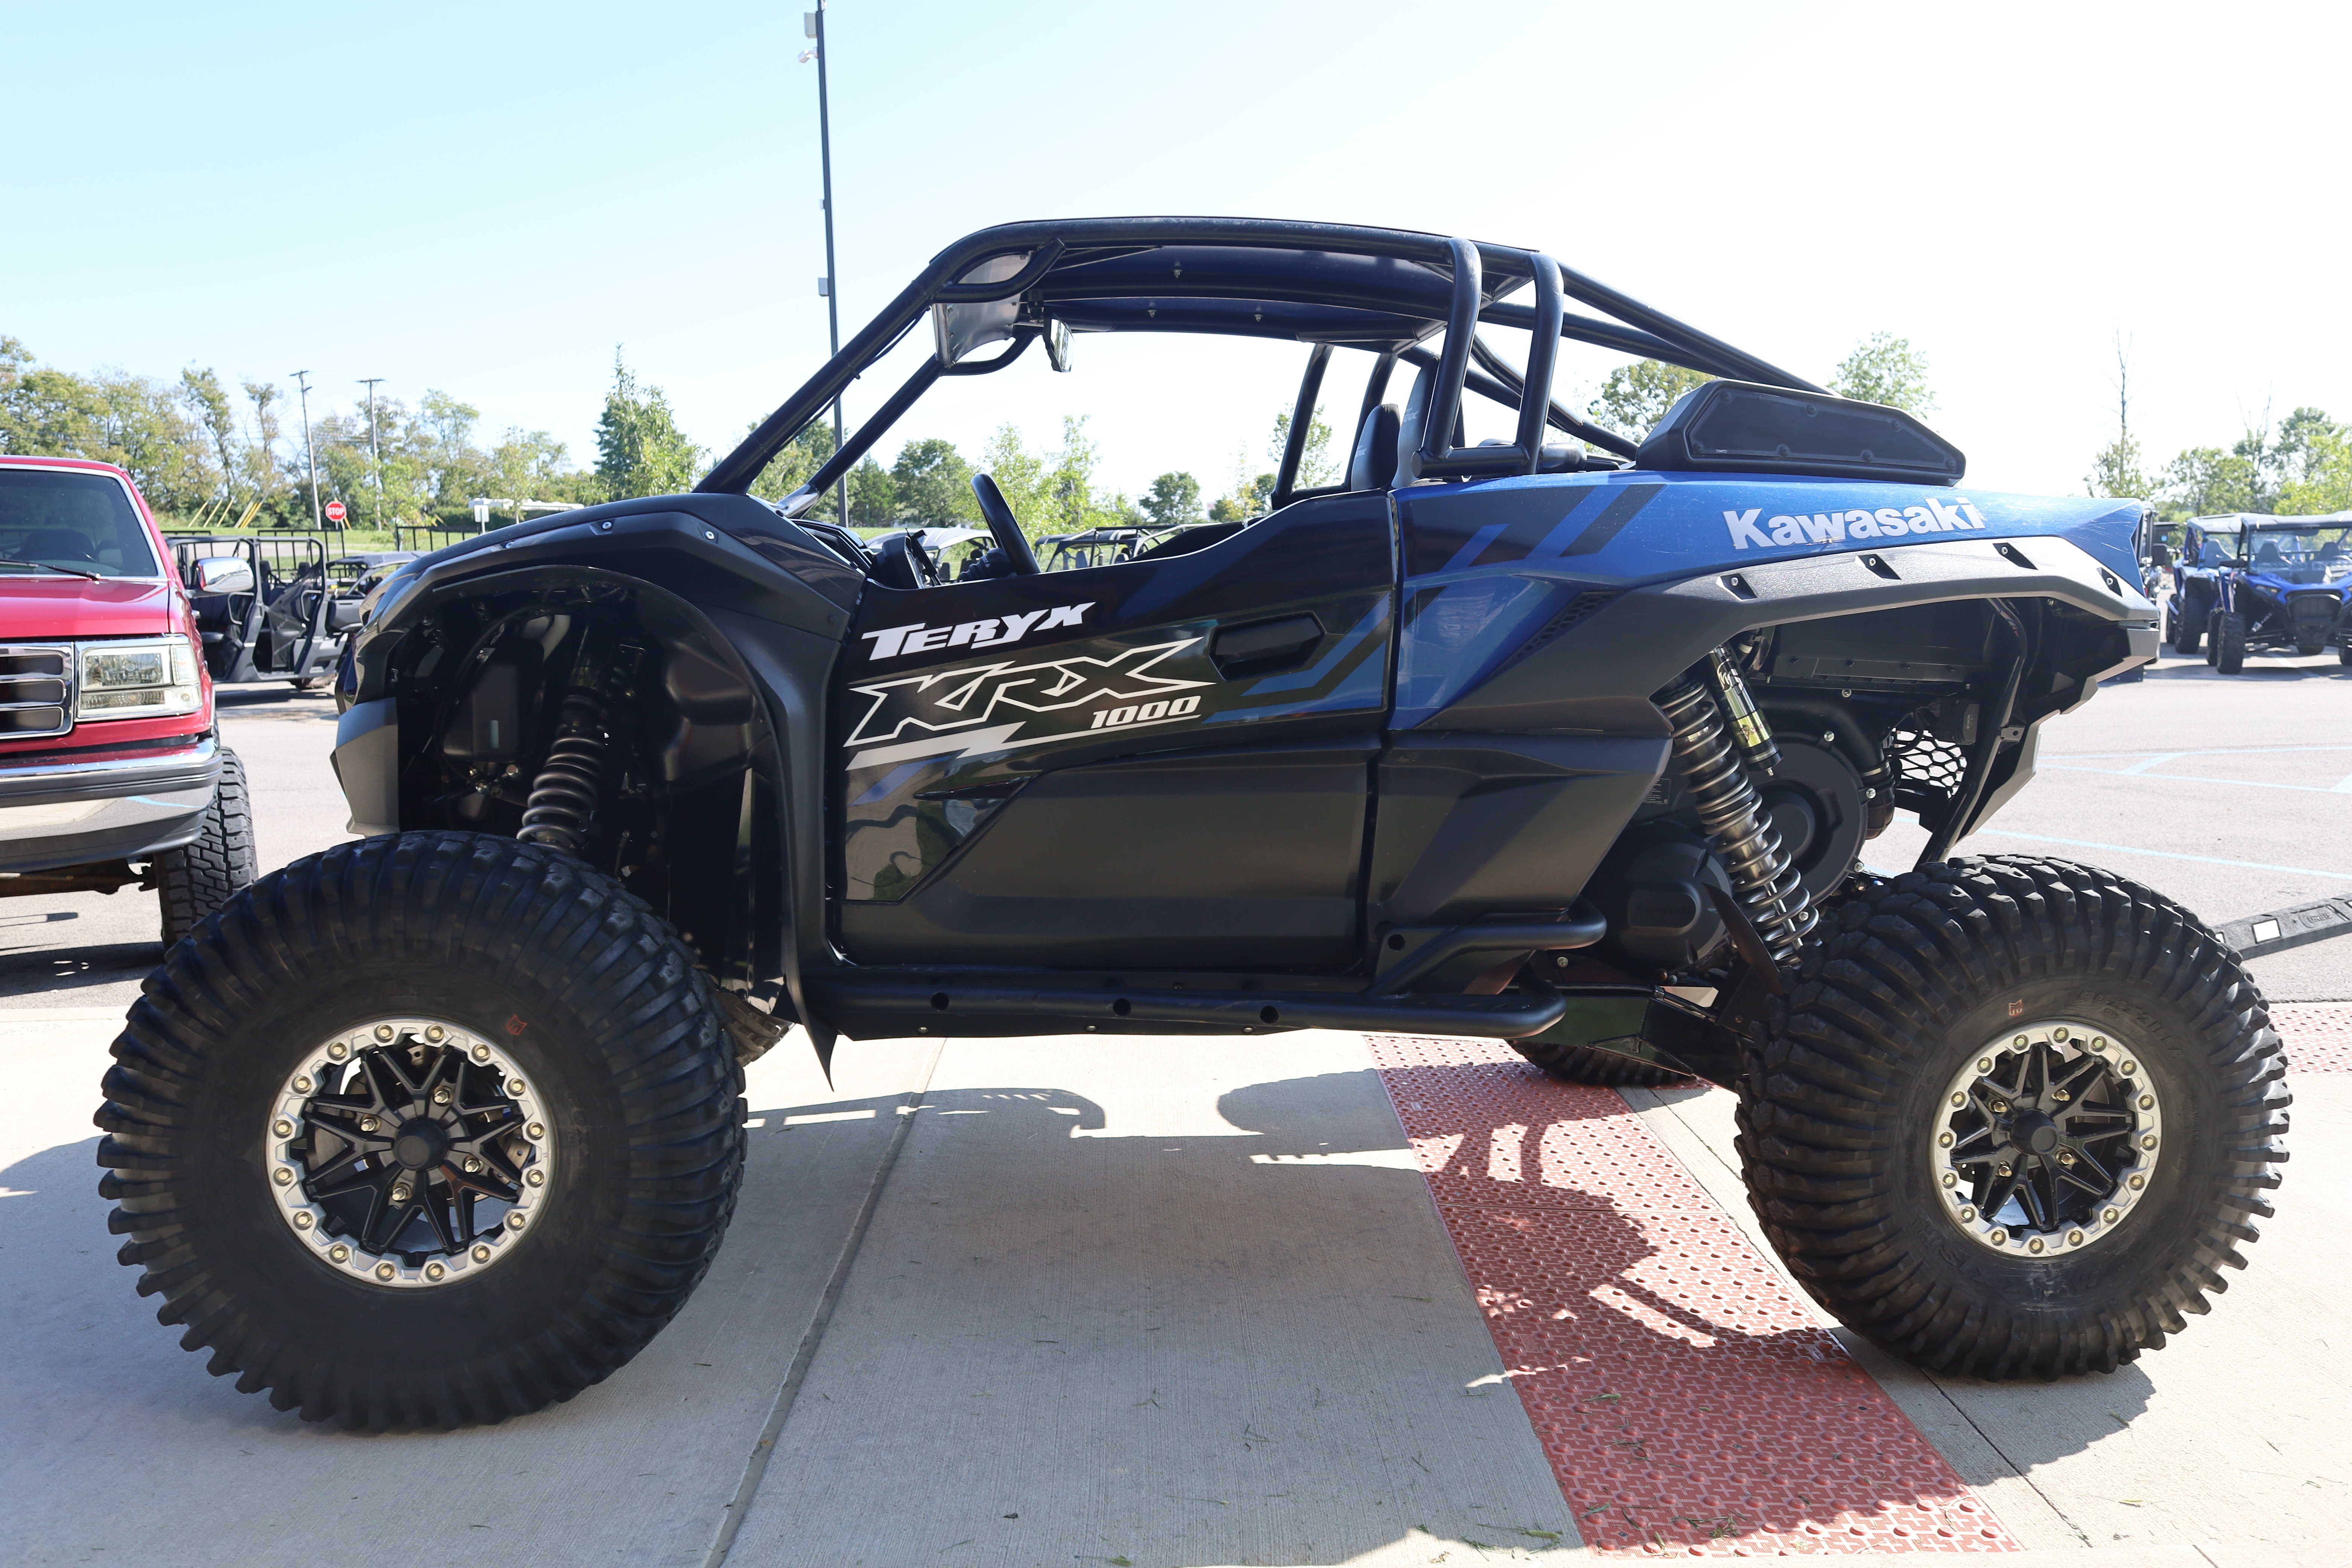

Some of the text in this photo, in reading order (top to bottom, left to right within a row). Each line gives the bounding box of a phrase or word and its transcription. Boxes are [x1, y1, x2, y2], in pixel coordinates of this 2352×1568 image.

[327, 507, 345, 516] STOP
[1723, 497, 1986, 550] Kawasaki
[861, 602, 1096, 661] TERYX
[844, 637, 1217, 748] KRX
[1090, 695, 1202, 729] 1000
